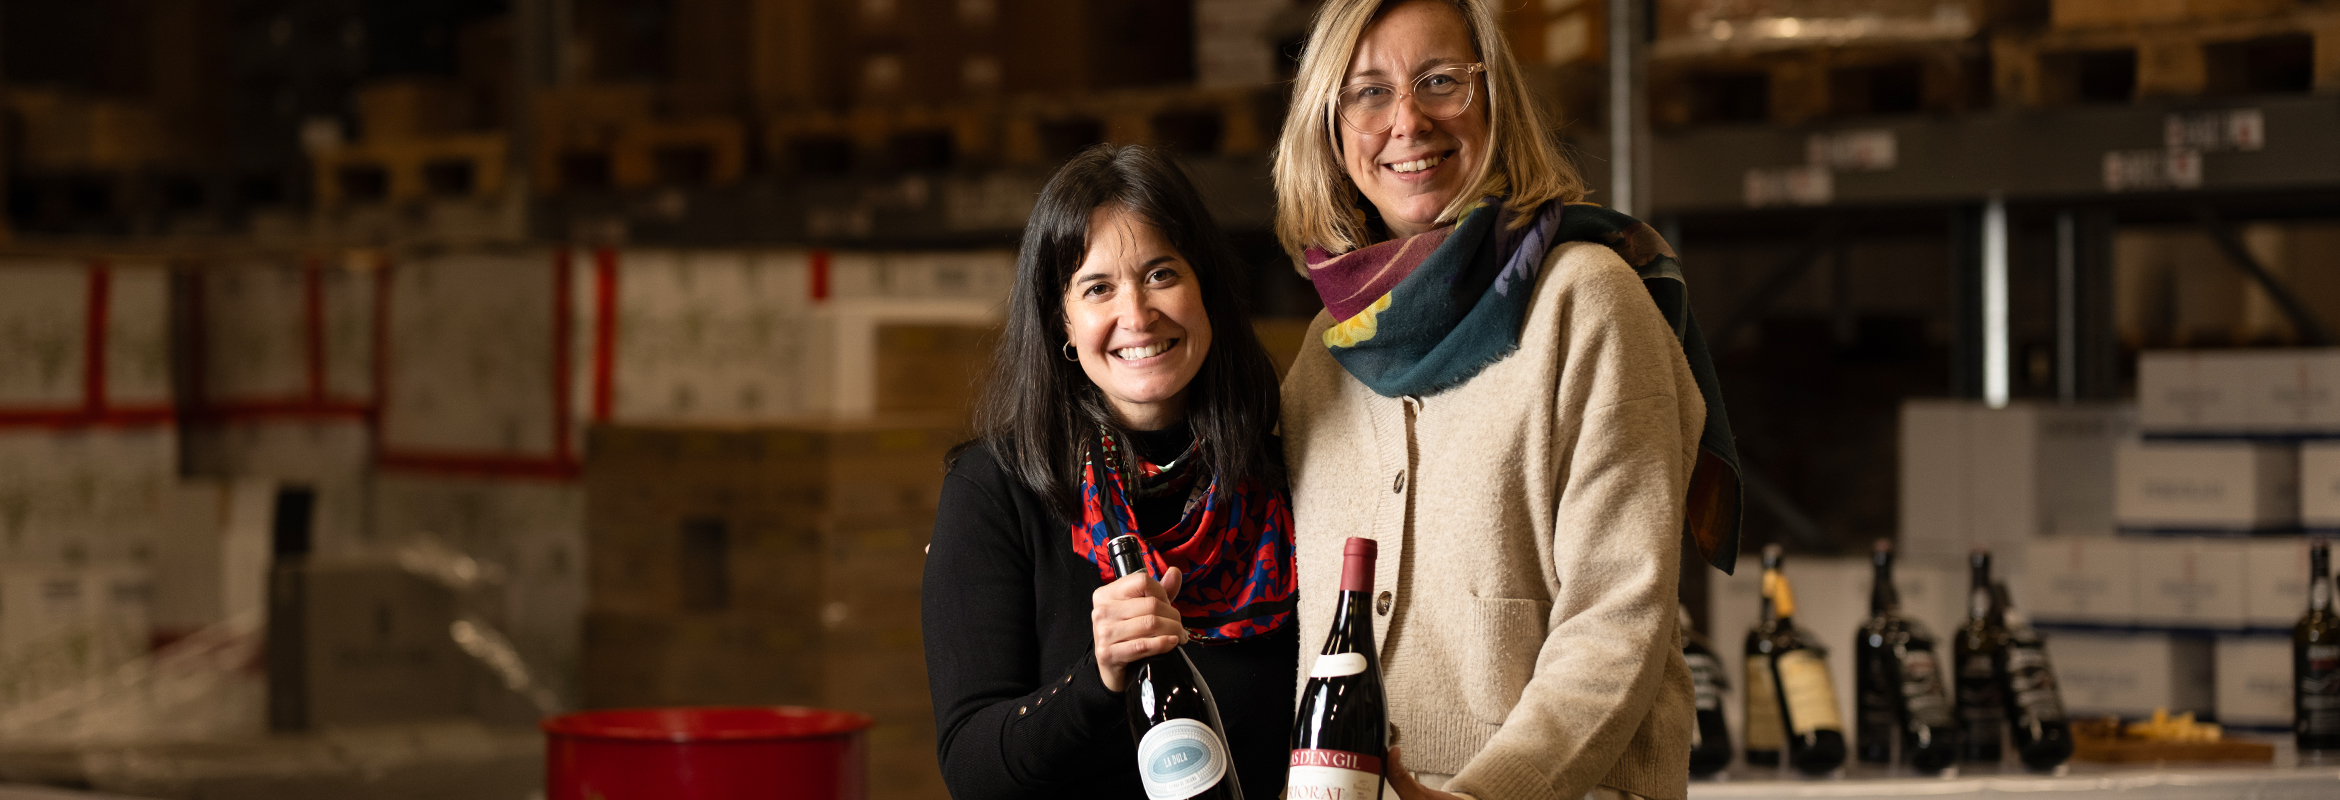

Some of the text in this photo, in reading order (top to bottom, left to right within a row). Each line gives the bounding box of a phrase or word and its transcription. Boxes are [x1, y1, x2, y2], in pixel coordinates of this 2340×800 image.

[1163, 752, 1188, 768] LA DULA
[1332, 753, 1360, 769] GIL
